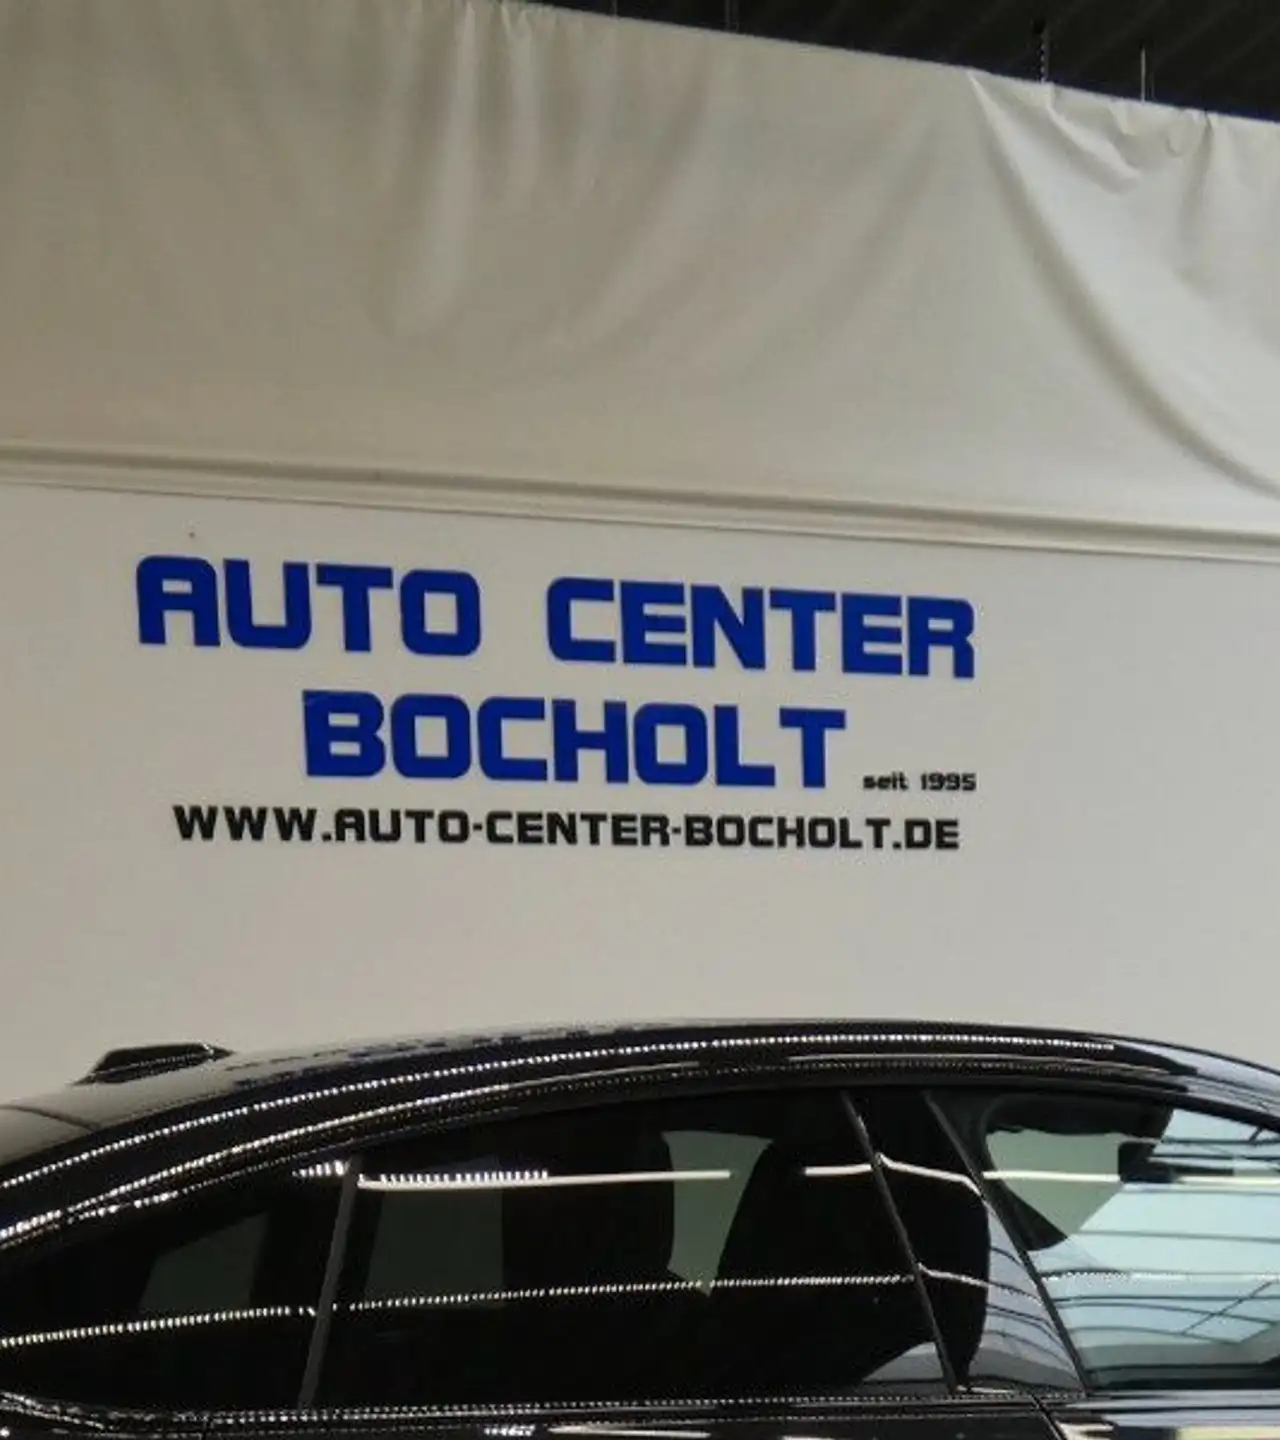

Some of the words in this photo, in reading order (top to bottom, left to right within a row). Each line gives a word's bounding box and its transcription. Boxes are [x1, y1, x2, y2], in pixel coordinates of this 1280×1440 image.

[136, 555, 482, 657] AUTO
[546, 577, 976, 679] CENTER
[303, 689, 847, 790] BOCHOLT
[862, 770, 910, 791] seit
[920, 771, 978, 792] 1995
[171, 804, 961, 851] WWW.AUTO-CENTER-BOCHOLT.DE
